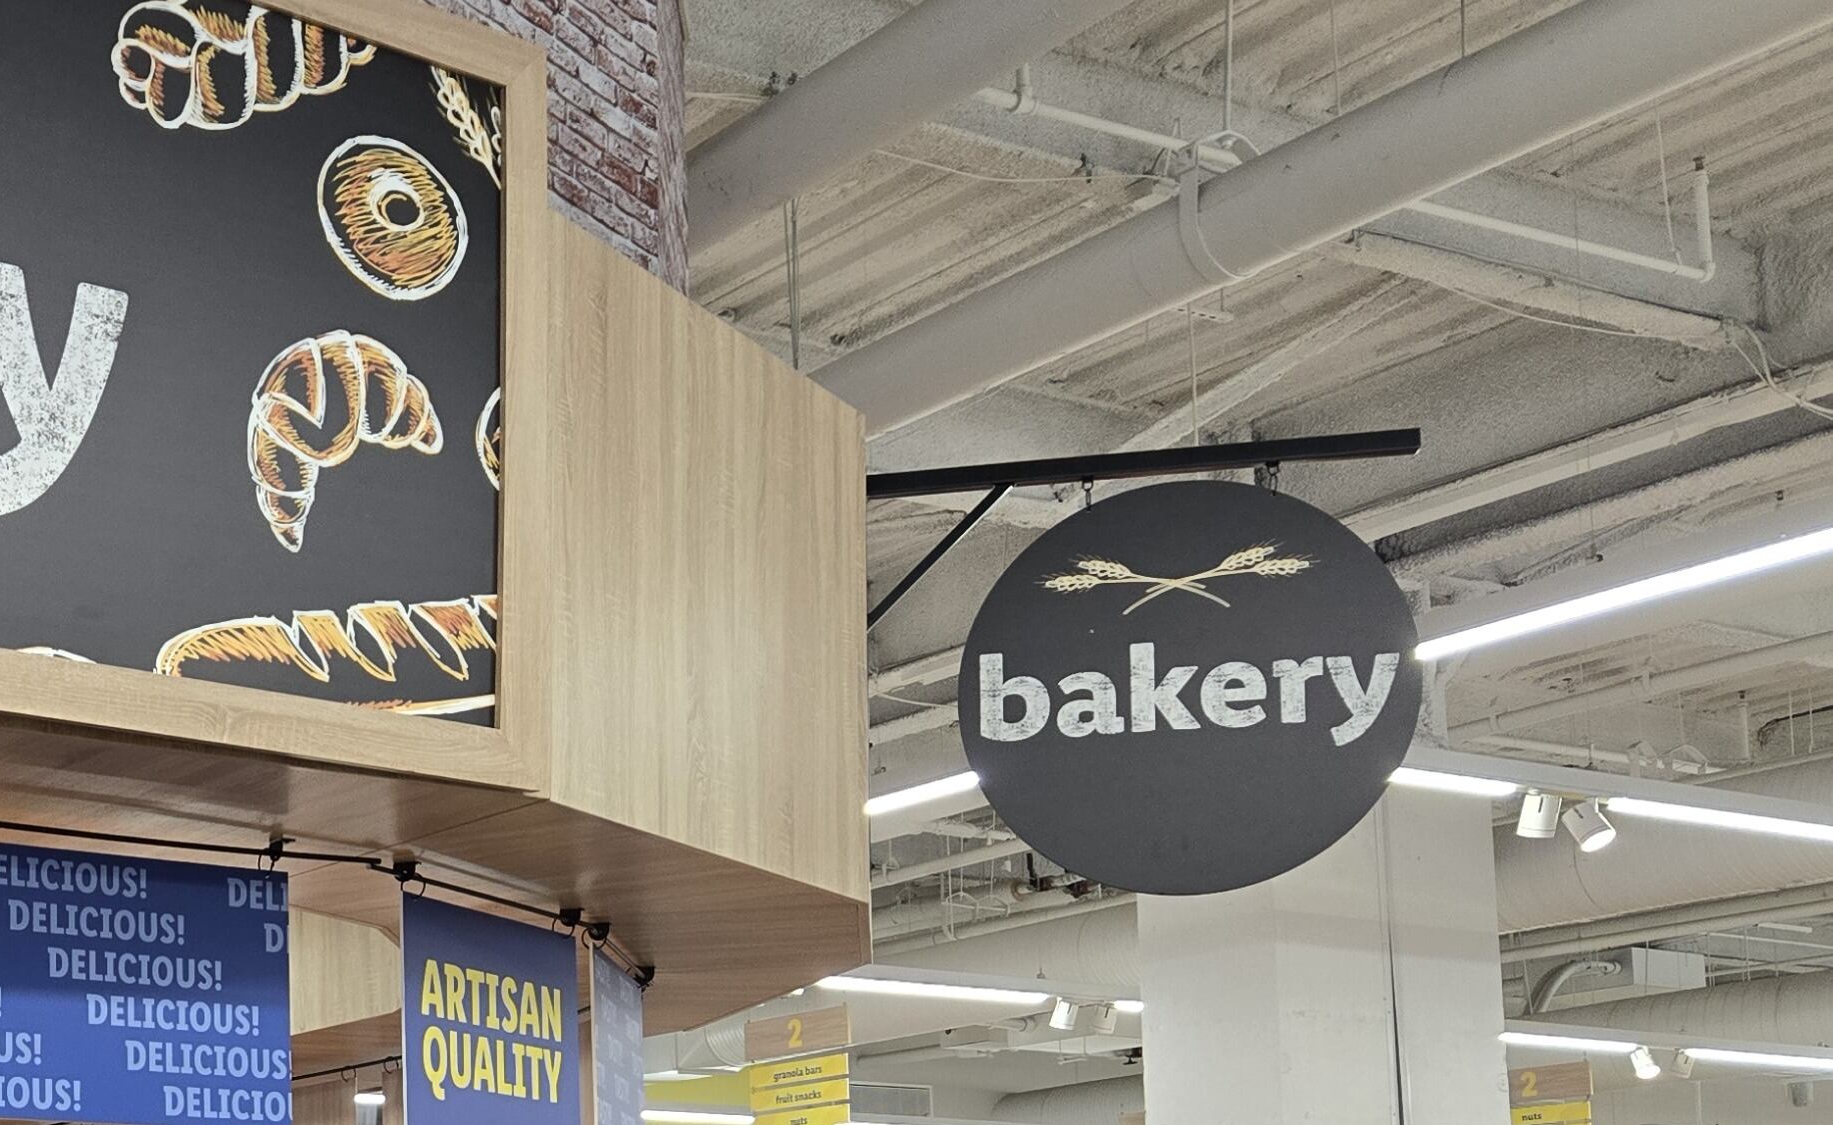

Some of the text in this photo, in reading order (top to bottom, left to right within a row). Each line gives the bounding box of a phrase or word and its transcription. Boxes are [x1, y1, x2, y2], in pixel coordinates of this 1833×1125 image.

[979, 642, 1400, 746] bakery
[8, 899, 186, 945] DELICIOUS!
[47, 946, 223, 991] DELICIOUS!
[86, 993, 260, 1036] DELICIOUS!
[421, 959, 562, 1043] ARTISAN
[788, 1019, 803, 1049] 2
[422, 1025, 562, 1104] QUALITY
[773, 1066, 823, 1082] granola bars
[1520, 1072, 1538, 1097] 2
[775, 1090, 822, 1105] fruit snacks
[1521, 1112, 1542, 1122] nuts
